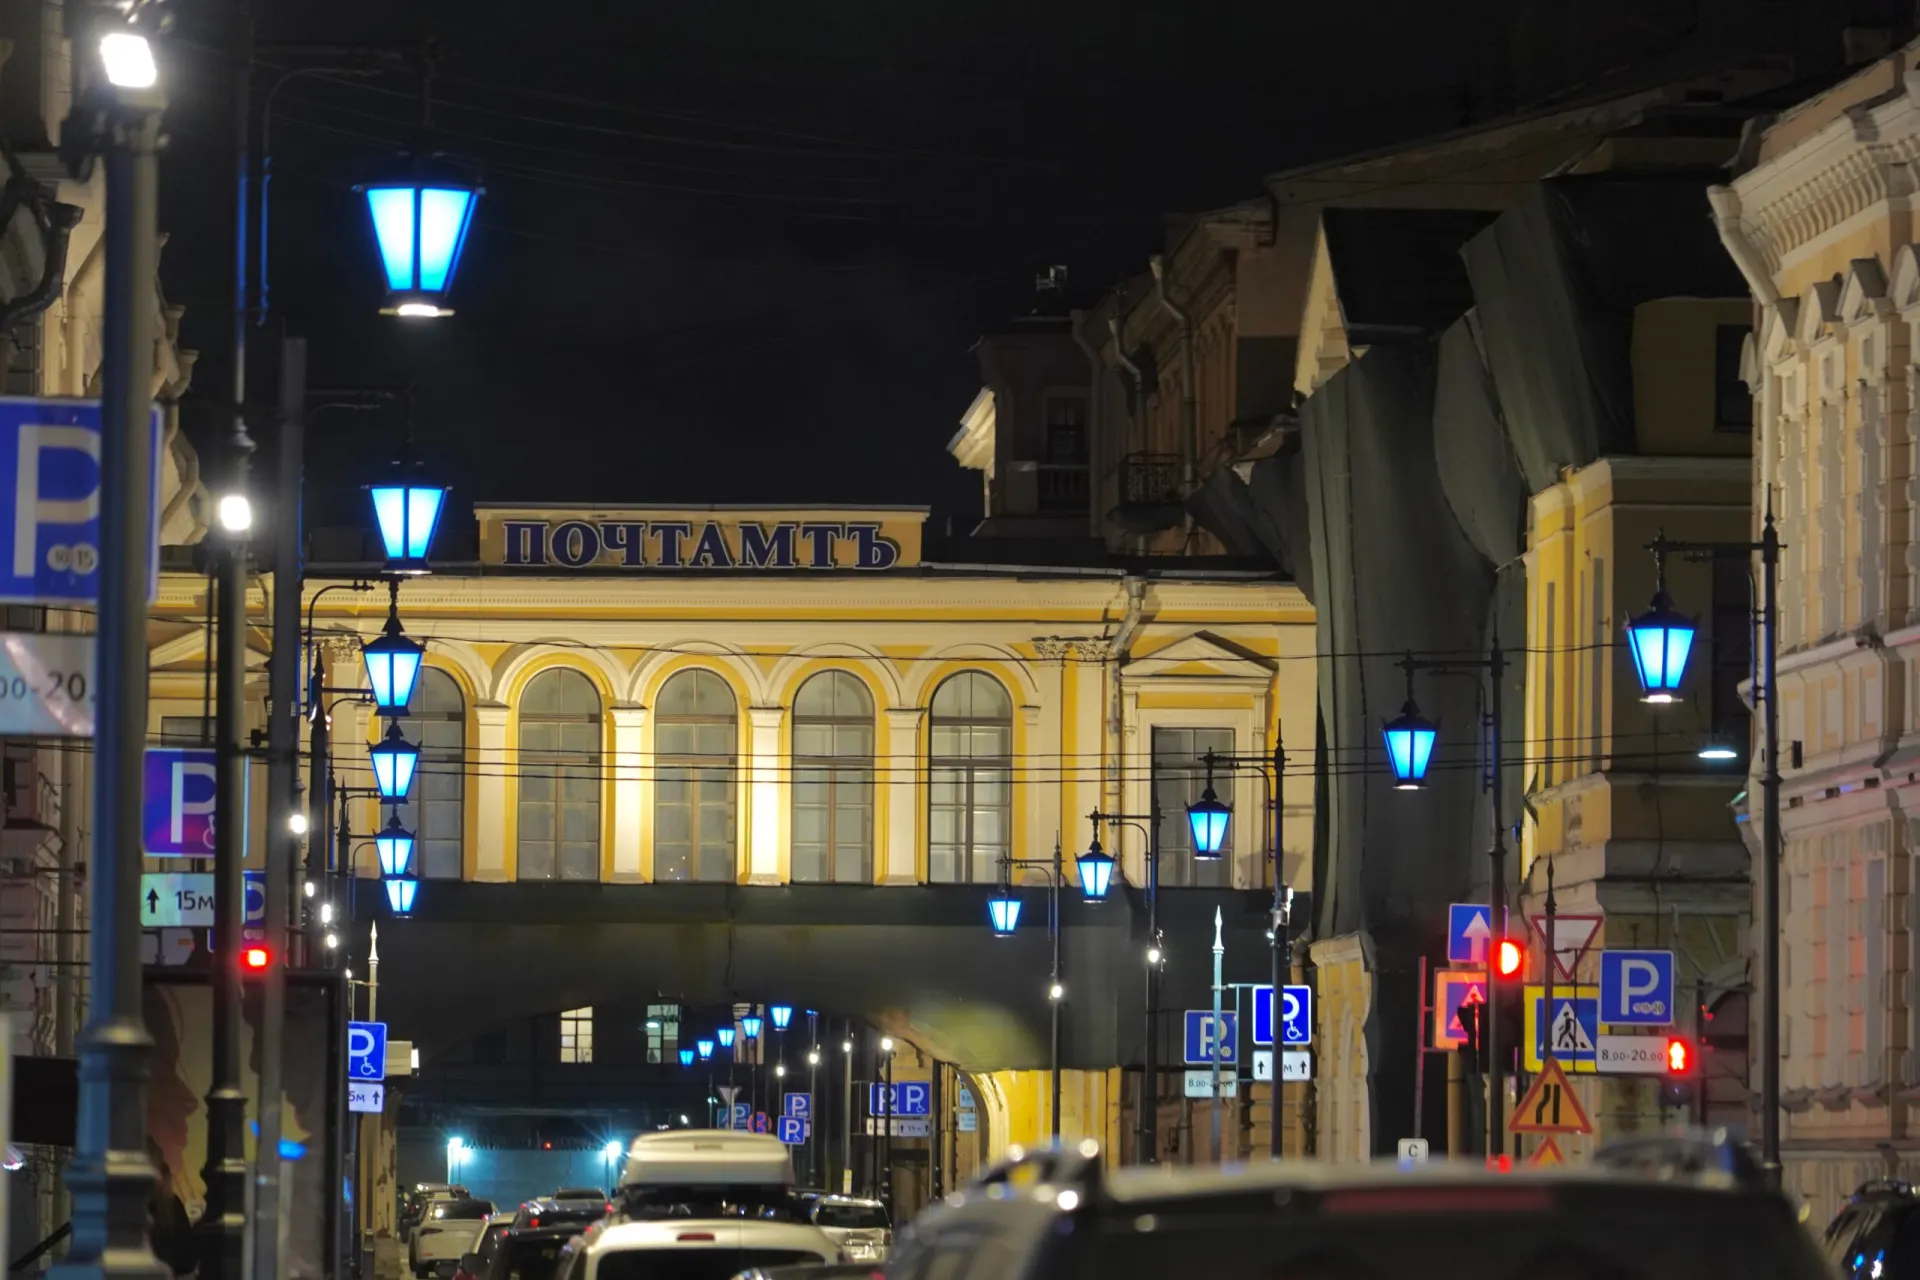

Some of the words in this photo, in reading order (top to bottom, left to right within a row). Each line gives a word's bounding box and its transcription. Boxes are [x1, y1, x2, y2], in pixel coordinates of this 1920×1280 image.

[14, 424, 101, 577] P
[503, 520, 899, 570] ПОЧТАМТЪ
[170, 762, 216, 843] P
[1621, 959, 1660, 1015] P
[1270, 992, 1300, 1038] P
[348, 1028, 375, 1073] P
[1200, 1017, 1227, 1057] P
[1601, 1049, 1664, 1061] 8.00-20.00
[792, 1096, 806, 1117] P
[878, 1086, 896, 1112] P
[906, 1085, 924, 1112] P
[785, 1119, 800, 1141] P
